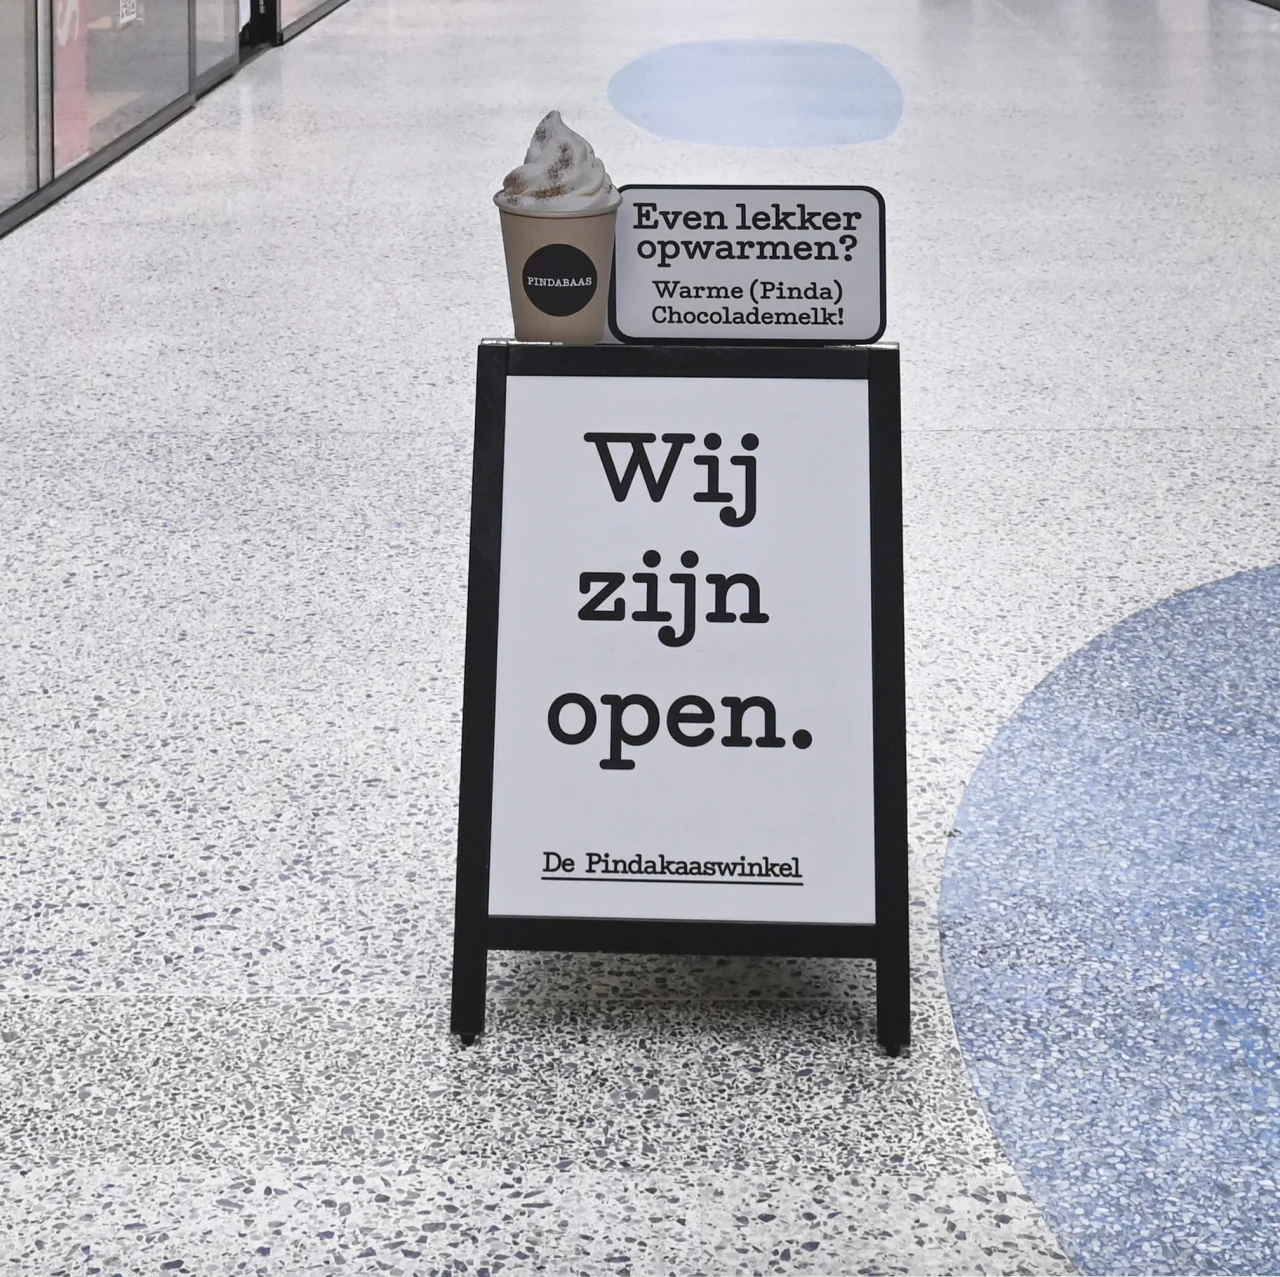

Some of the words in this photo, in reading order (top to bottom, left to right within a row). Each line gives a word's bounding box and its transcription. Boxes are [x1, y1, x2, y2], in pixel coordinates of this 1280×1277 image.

[633, 202, 728, 231] Even
[735, 203, 862, 231] lekker
[637, 233, 858, 268] opwarmen?
[527, 275, 593, 288] PINDABAAS
[652, 280, 744, 300] Warme
[749, 278, 844, 304] (Pinda)
[651, 305, 845, 326] Chocolademelk!
[583, 431, 761, 528] Wij
[577, 549, 770, 648] zijn
[547, 691, 813, 771] open.
[542, 851, 575, 873] De
[585, 851, 803, 879] Pindakaaswinkel
